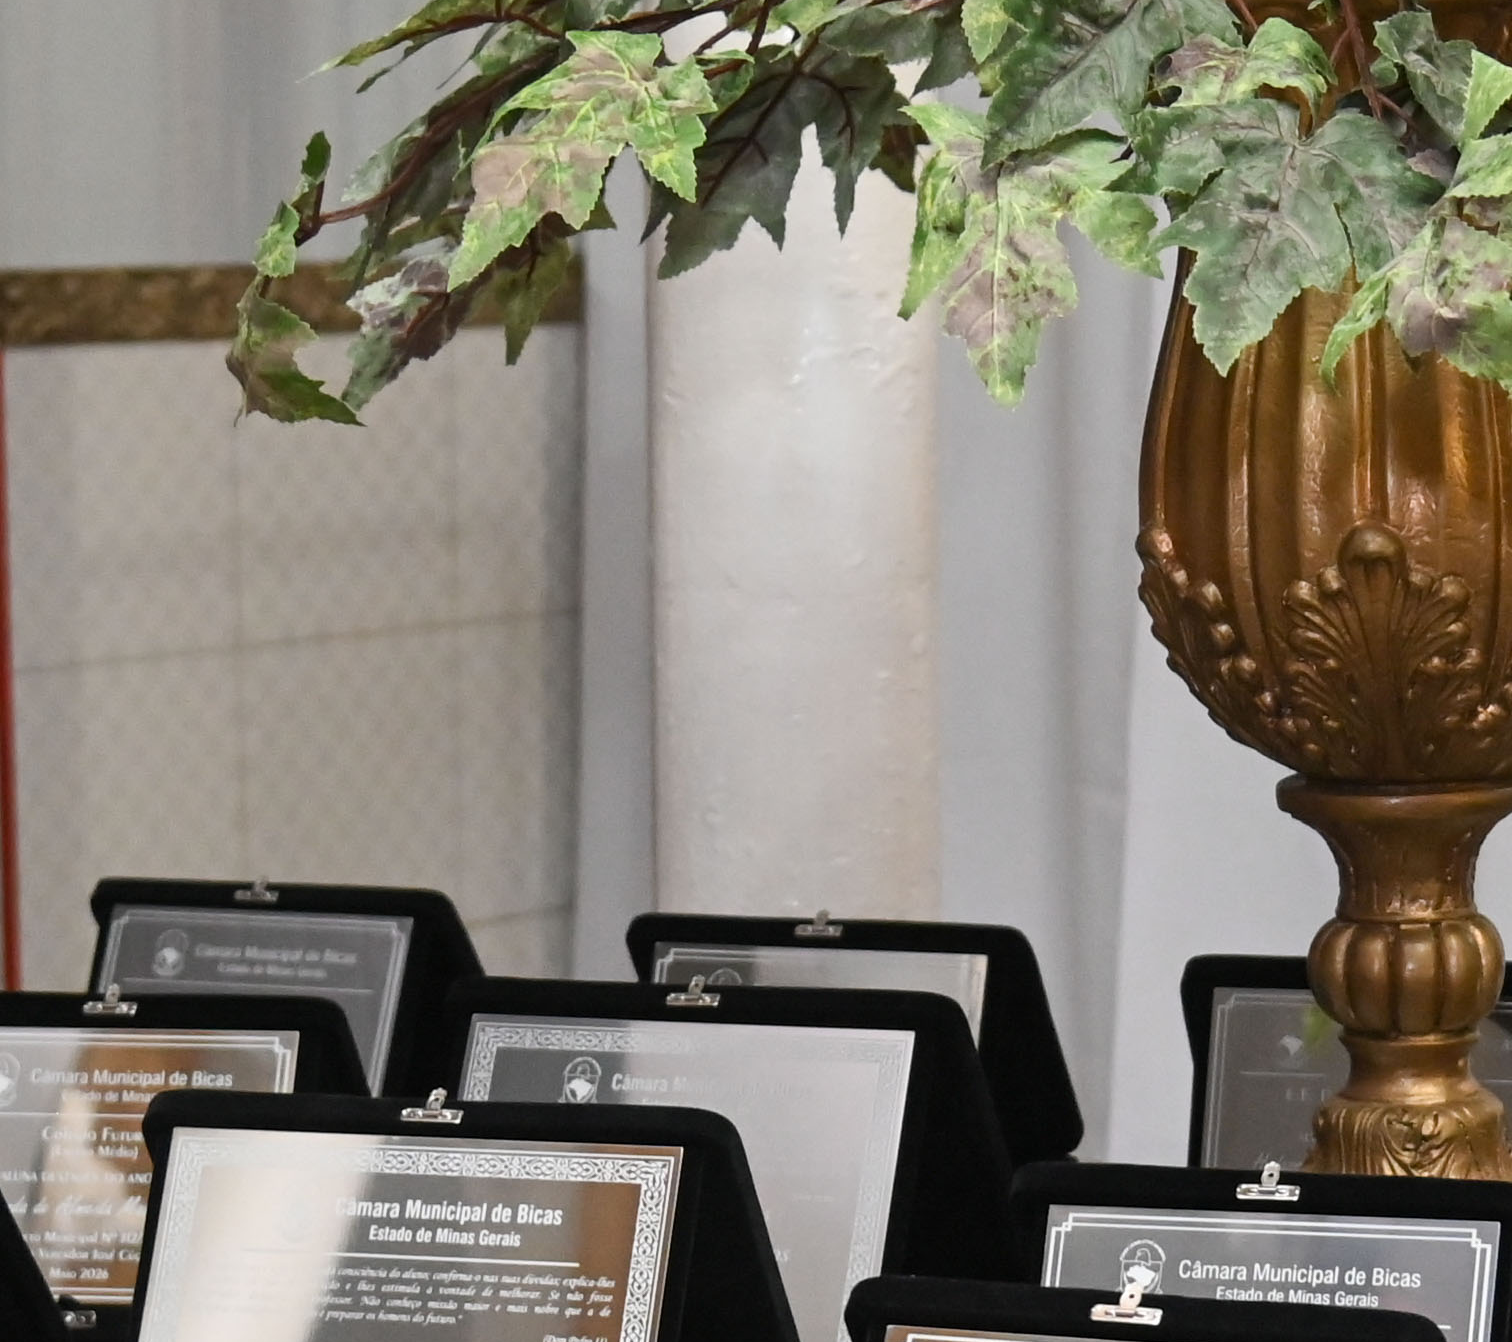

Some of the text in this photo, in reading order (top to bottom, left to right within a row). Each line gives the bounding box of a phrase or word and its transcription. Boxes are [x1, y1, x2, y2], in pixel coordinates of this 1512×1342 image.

[405, 1199, 487, 1225] Municipal
[491, 1203, 512, 1223] de
[517, 1204, 563, 1226] Bicas
[368, 1224, 521, 1247] Estado de Minas Gerais
